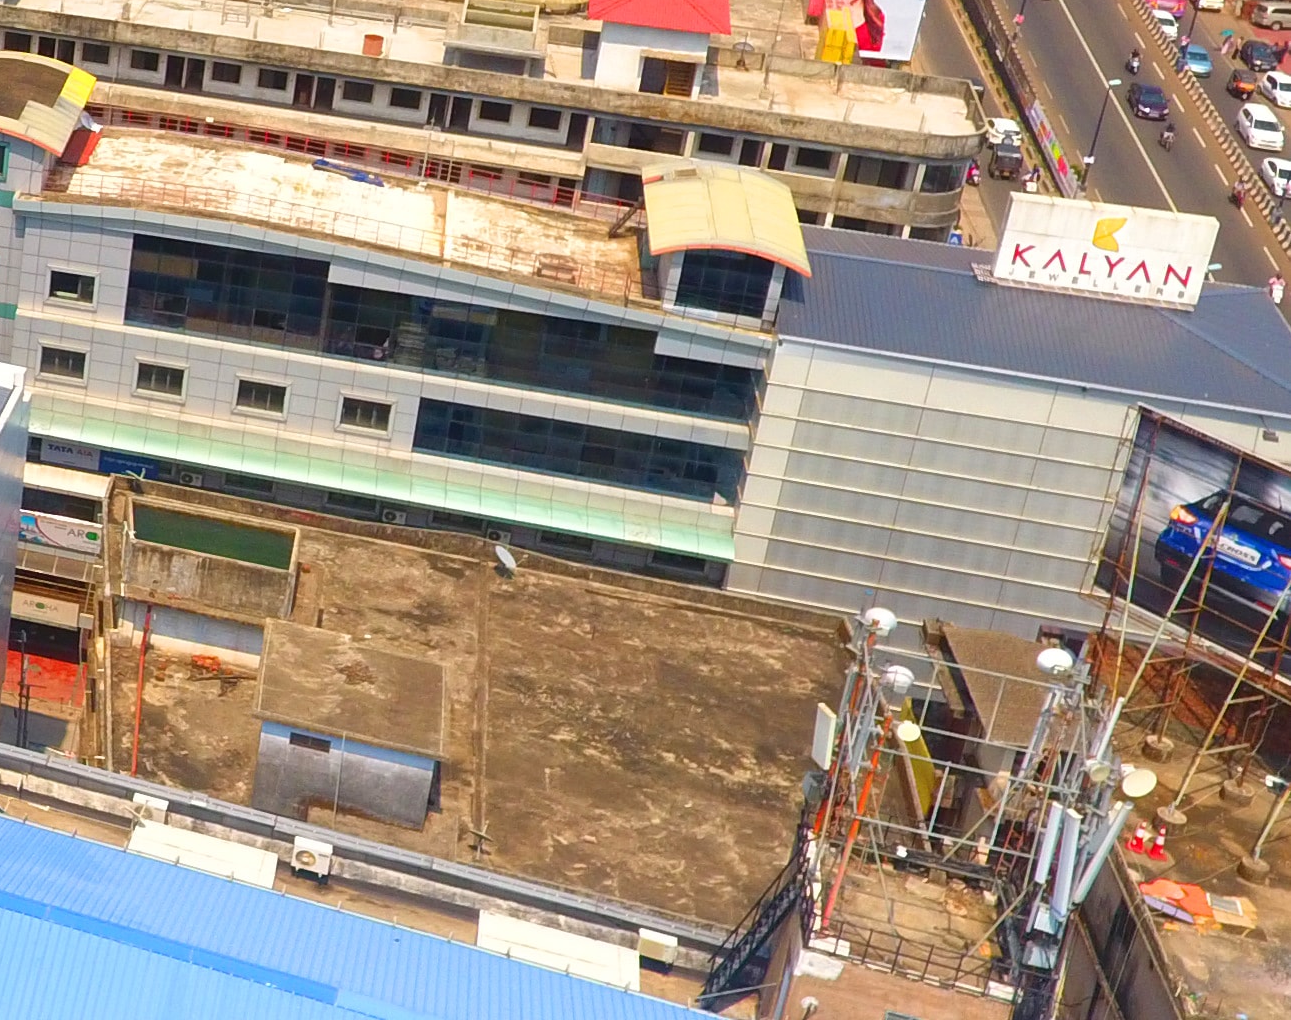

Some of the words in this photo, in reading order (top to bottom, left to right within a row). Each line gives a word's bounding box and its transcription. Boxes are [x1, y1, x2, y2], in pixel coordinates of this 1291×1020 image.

[1011, 243, 1193, 289] KALYAN
[1008, 268, 1186, 299] JEWELLERS
[47, 443, 74, 455] TATA
[76, 448, 94, 458] AIA
